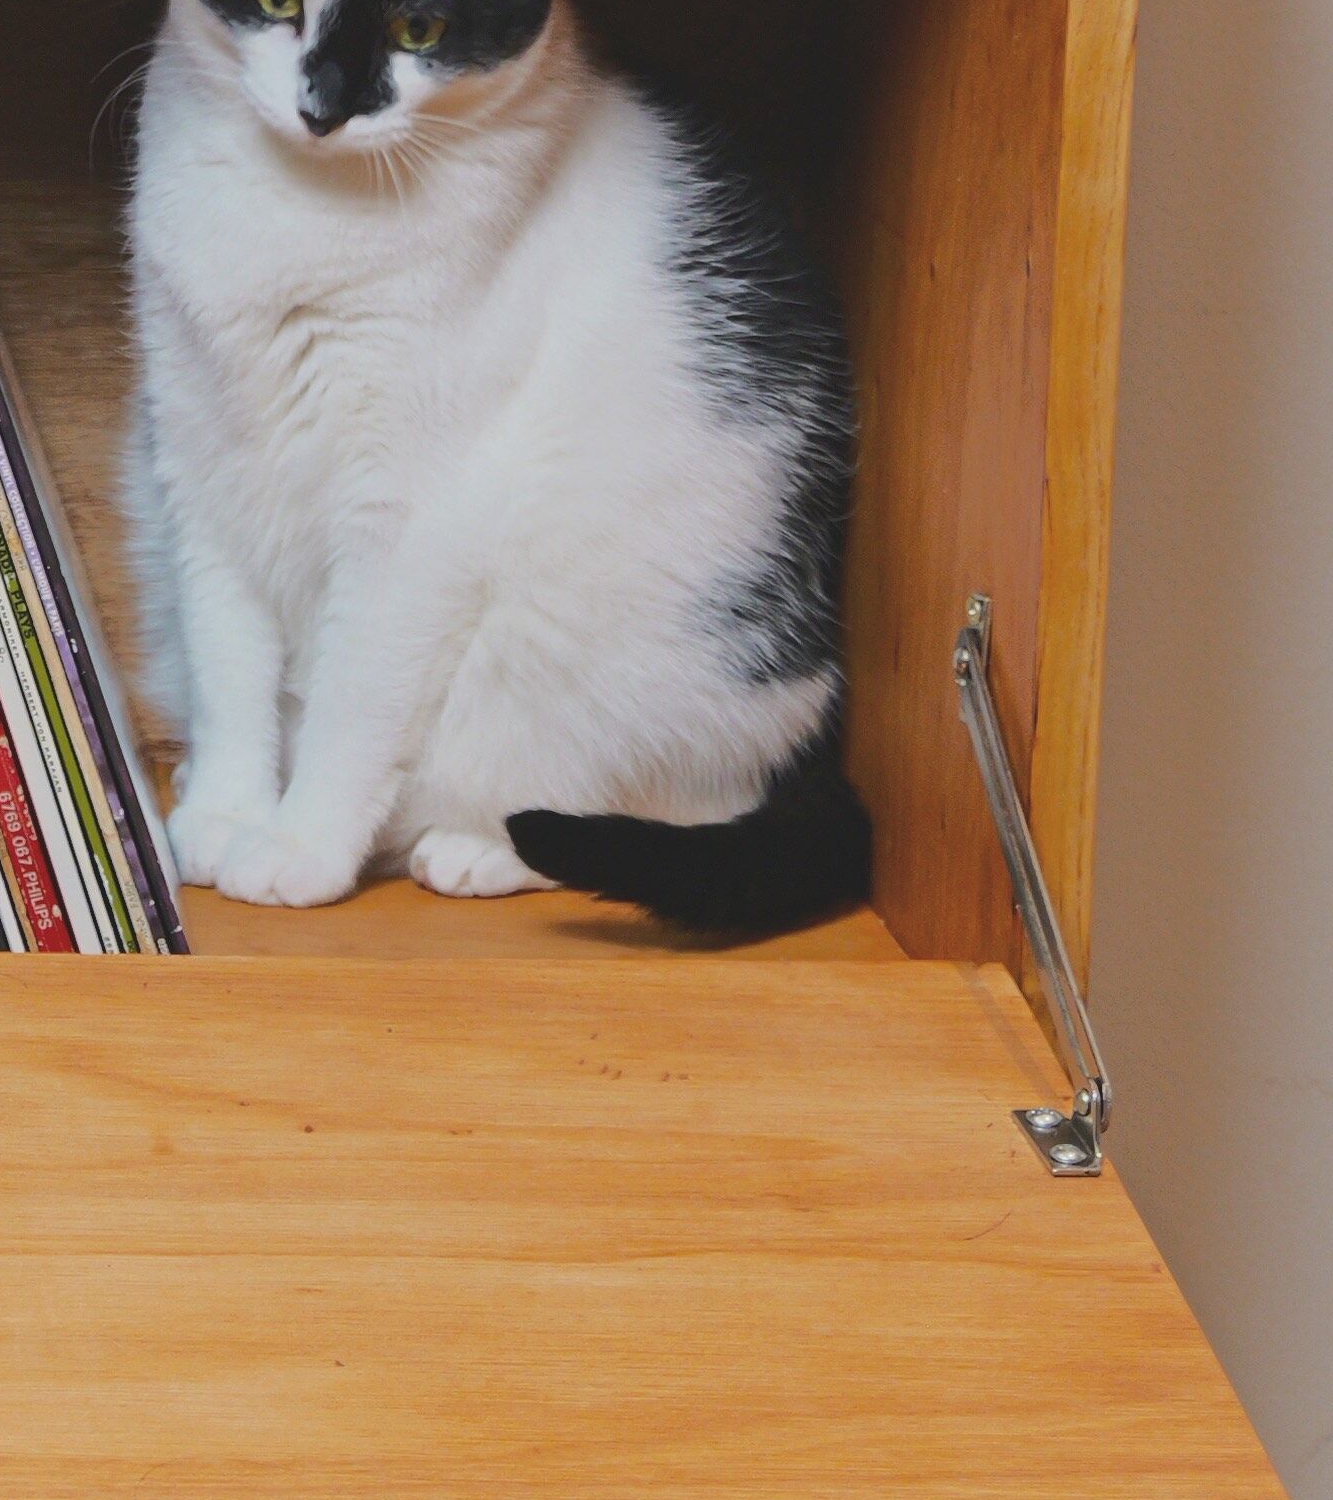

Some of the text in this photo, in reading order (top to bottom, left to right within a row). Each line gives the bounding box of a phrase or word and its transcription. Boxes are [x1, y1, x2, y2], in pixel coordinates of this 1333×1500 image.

[7, 489, 35, 549] COLLECTION
[8, 588, 36, 640] PLAYS
[35, 721, 47, 743] VON
[21, 869, 53, 931] PHILIPS
